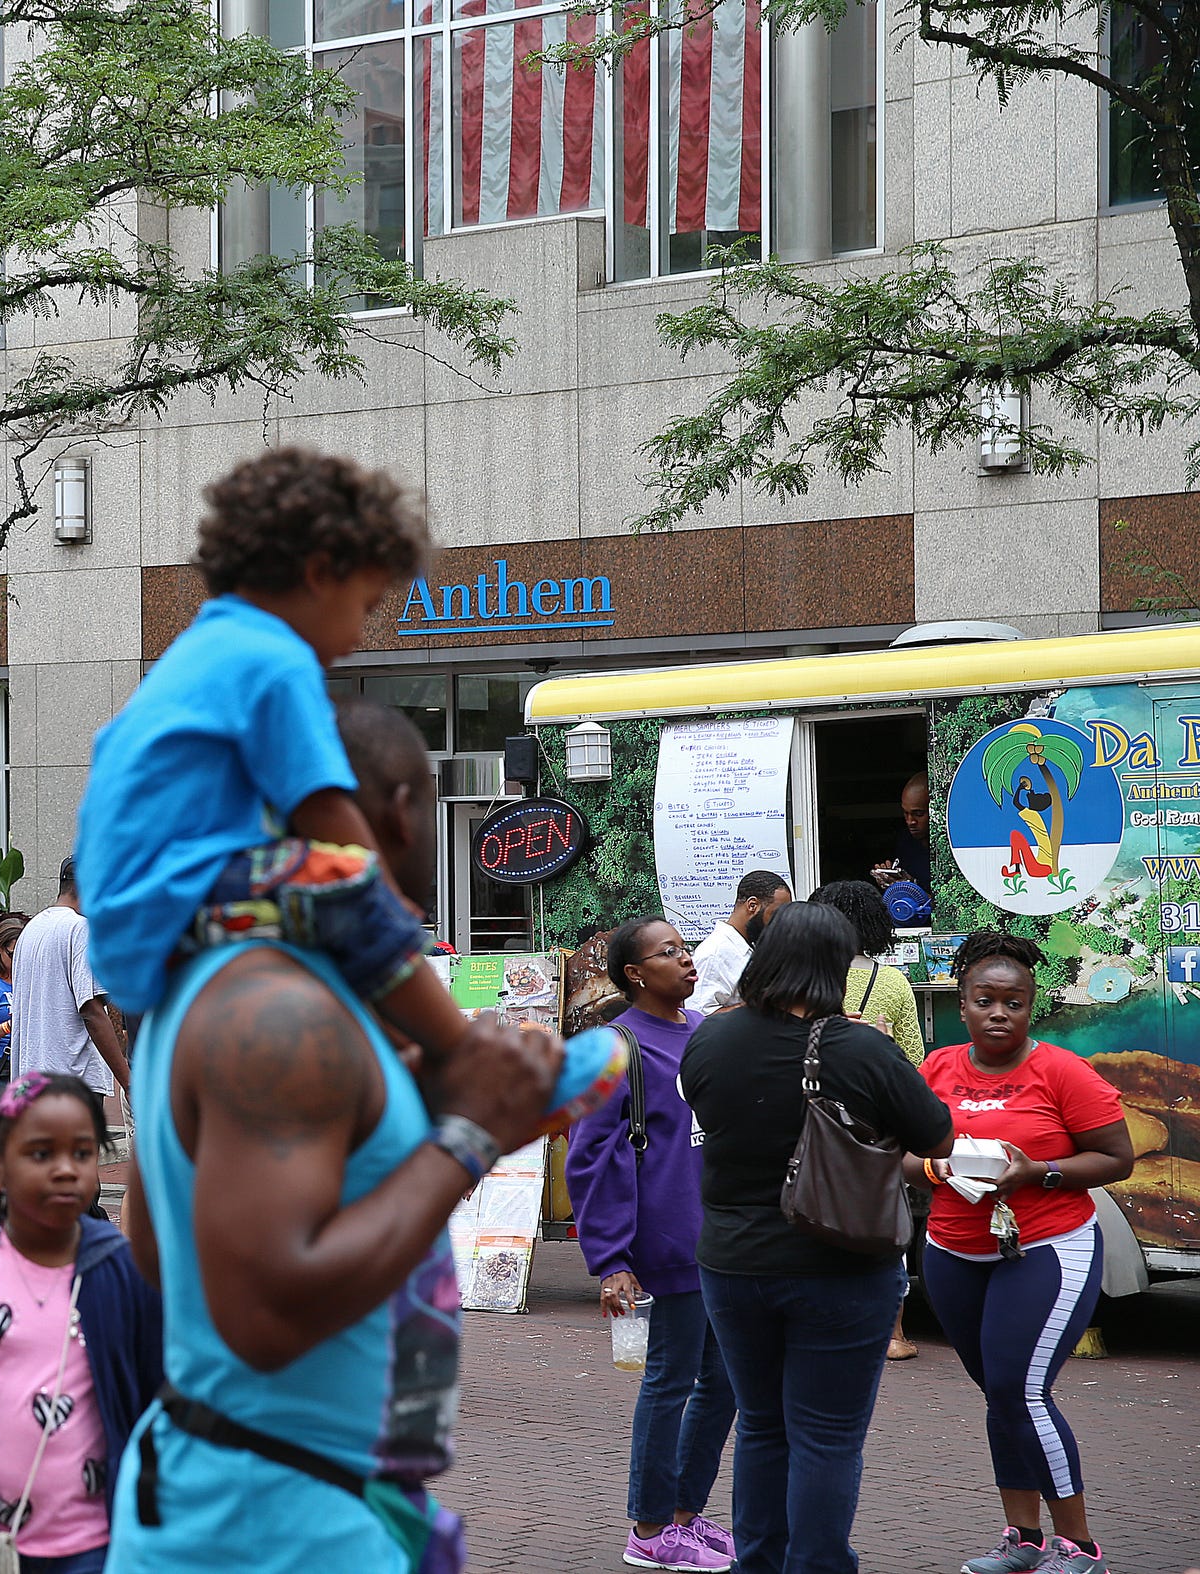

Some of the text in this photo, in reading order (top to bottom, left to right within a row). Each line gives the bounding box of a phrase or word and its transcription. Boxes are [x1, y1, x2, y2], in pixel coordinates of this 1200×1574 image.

[397, 559, 615, 622] Anthem
[1086, 718, 1161, 769] Da
[481, 813, 573, 869] OPEN
[470, 962, 498, 971] BITES
[932, 947, 951, 955] TIPS
[956, 1099, 1009, 1112] SUCK
